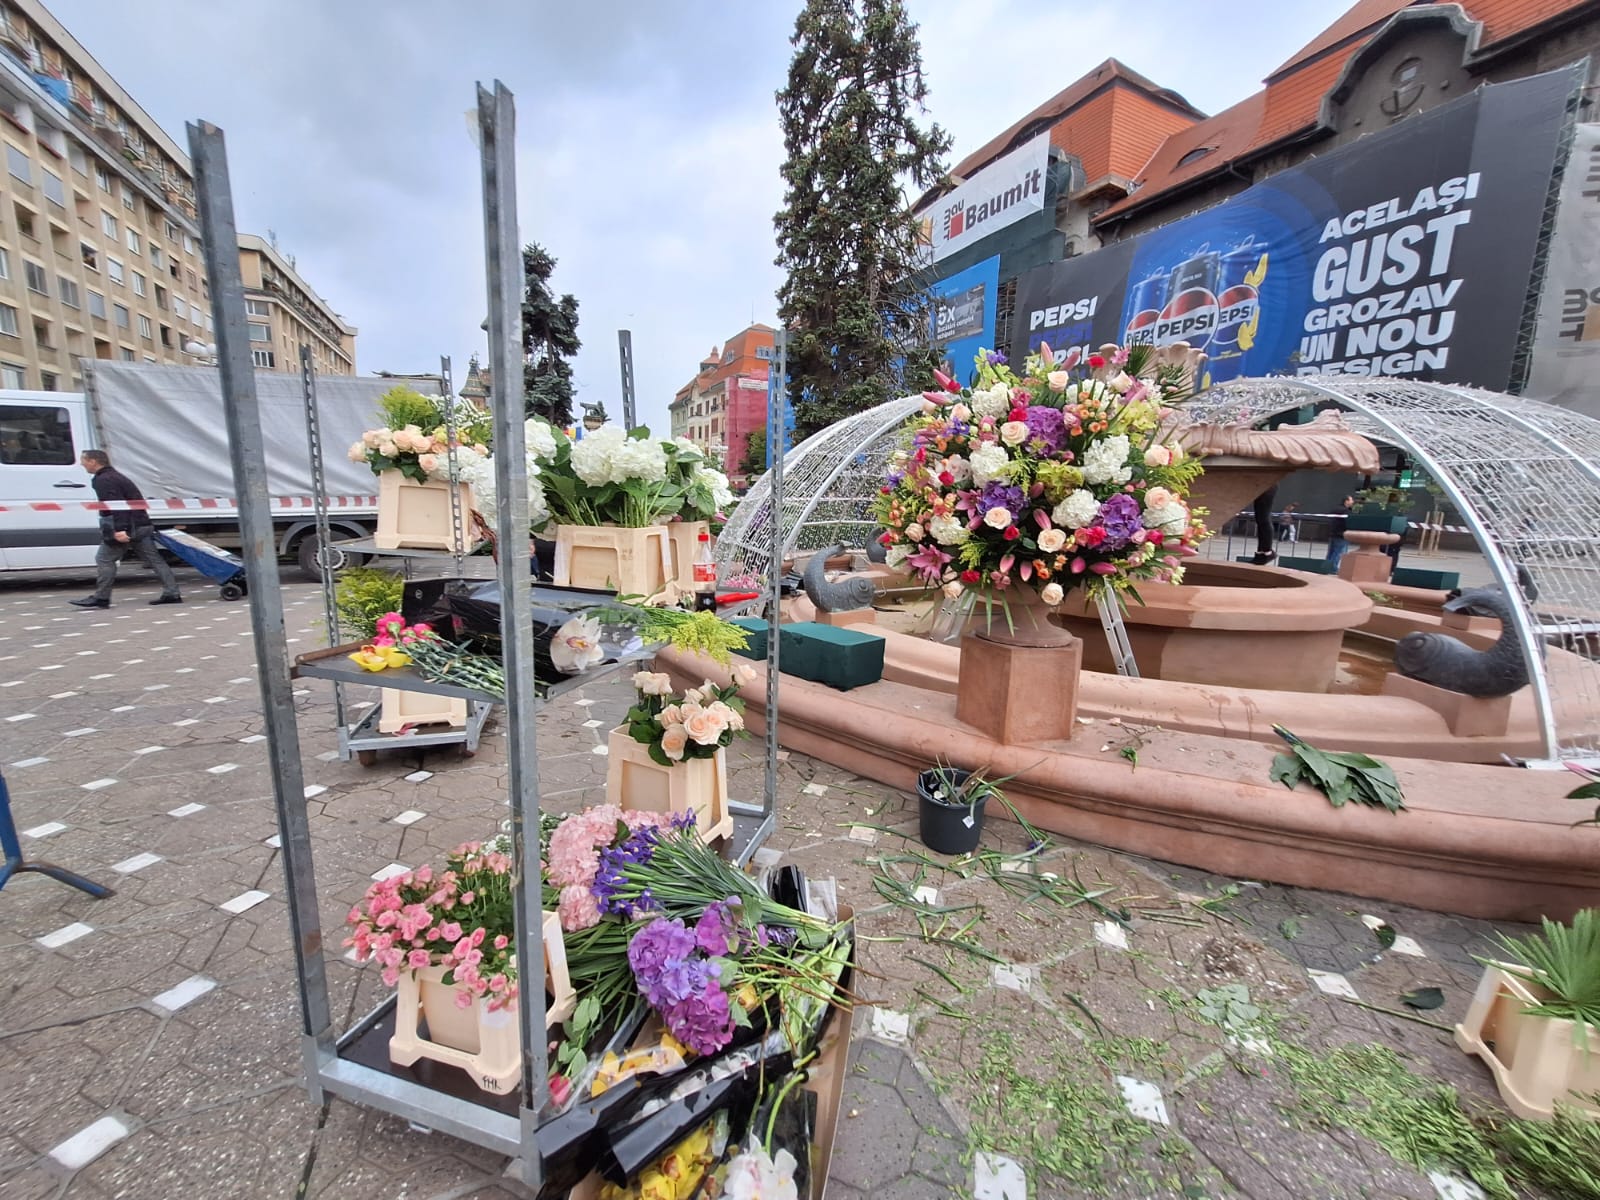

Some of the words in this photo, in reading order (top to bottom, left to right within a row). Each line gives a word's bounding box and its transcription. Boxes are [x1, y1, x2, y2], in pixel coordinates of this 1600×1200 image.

[965, 168, 1042, 231] Baumit
[1318, 172, 1481, 244] ACELAȘI
[1312, 209, 1472, 302] GUST
[1030, 295, 1098, 331] PEPSI
[1157, 312, 1215, 339] PEPSI
[1220, 305, 1254, 324] EPSI
[1304, 279, 1464, 333] GROZAV
[1300, 332, 1336, 363] UN
[1345, 310, 1456, 357] NOU
